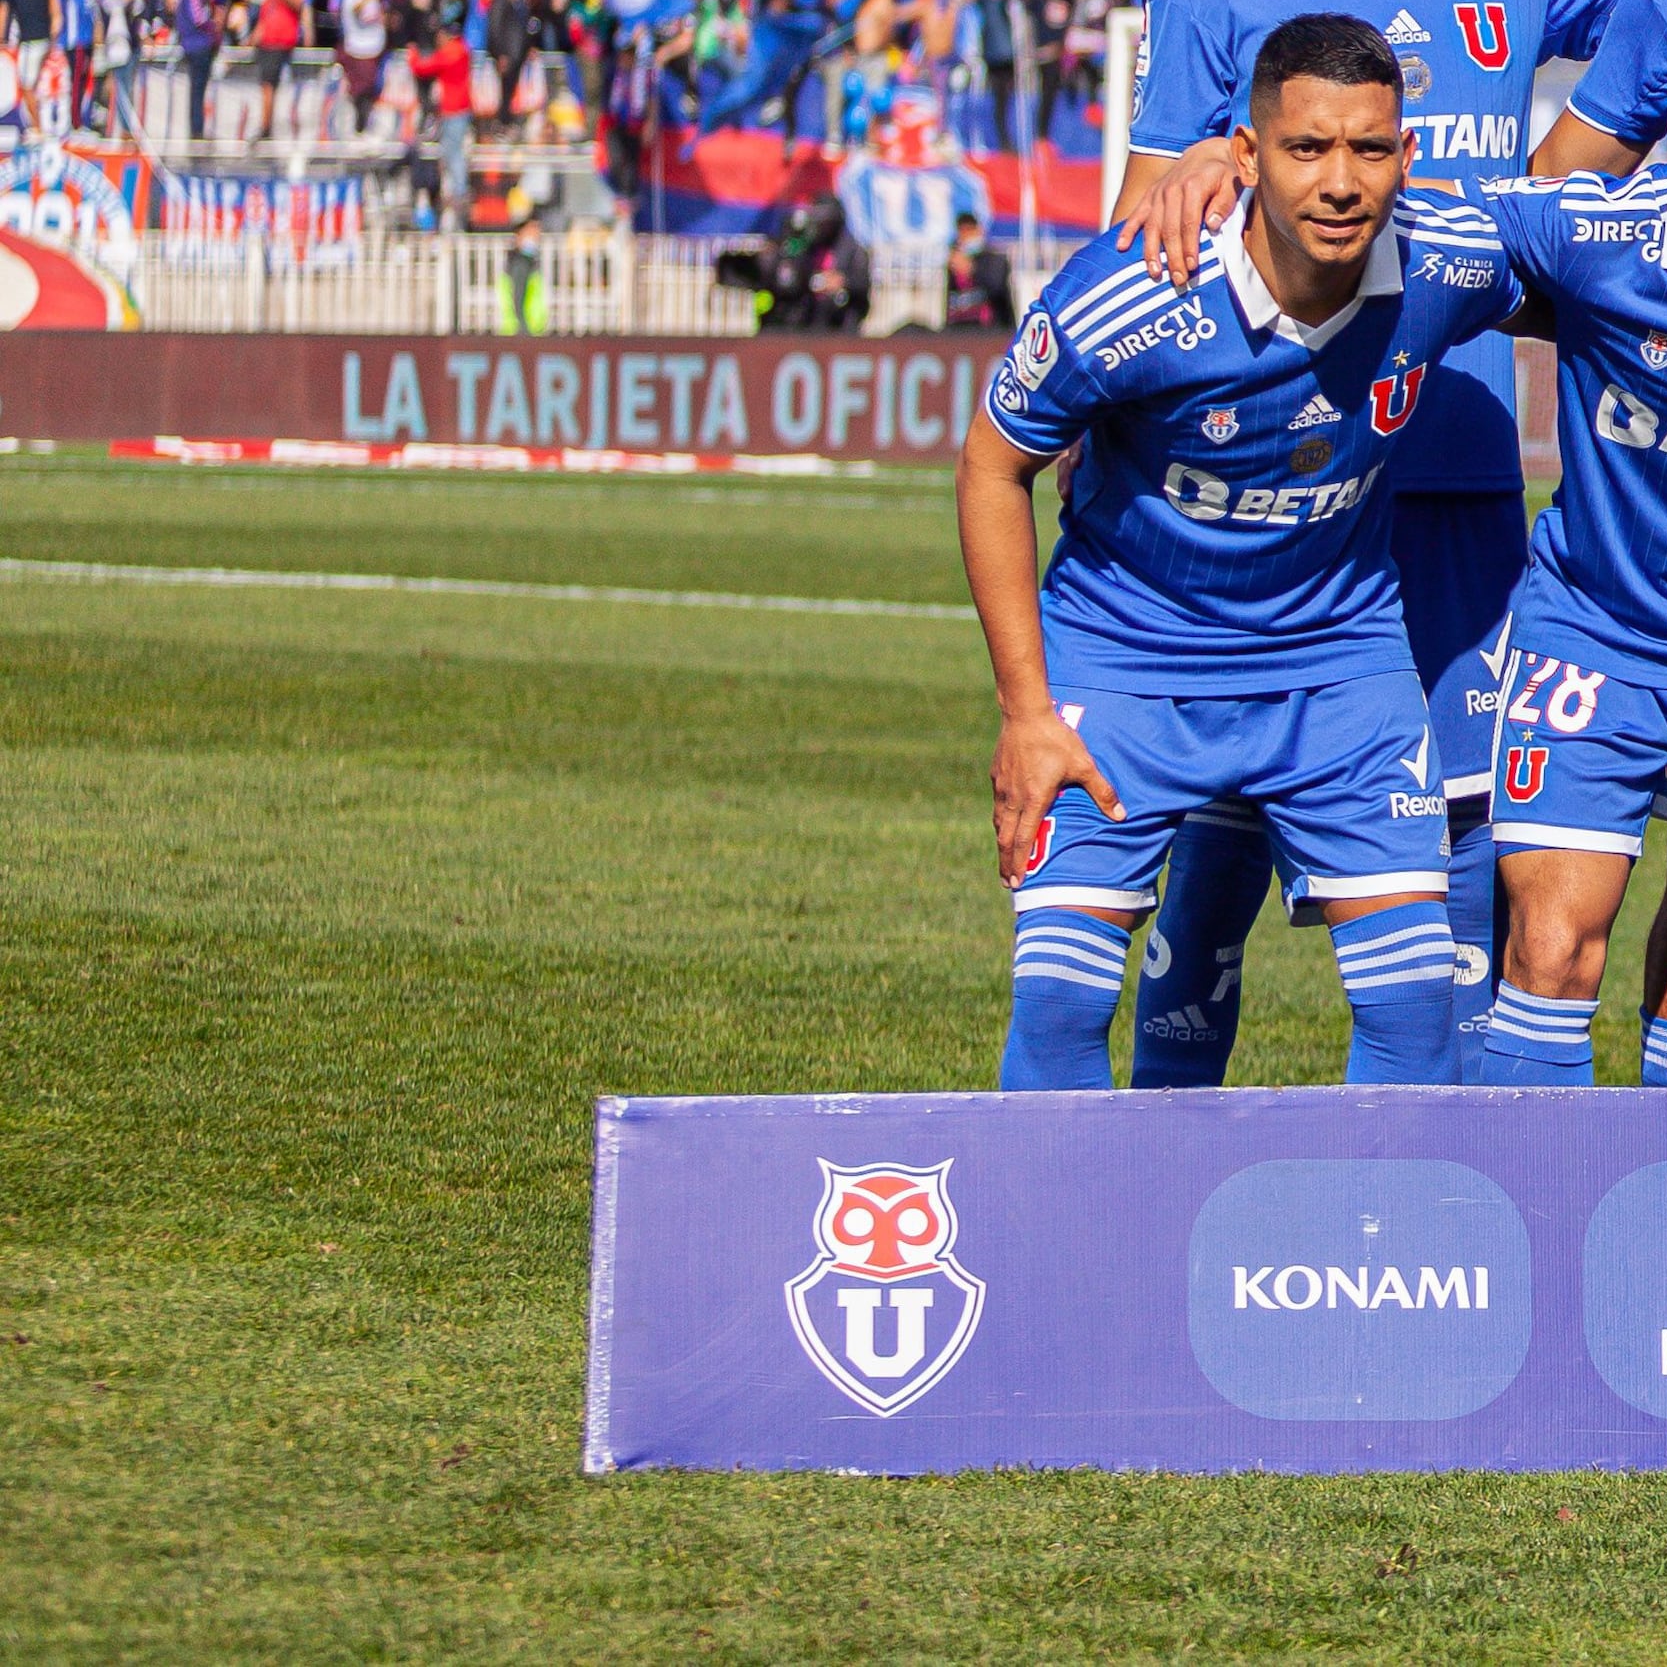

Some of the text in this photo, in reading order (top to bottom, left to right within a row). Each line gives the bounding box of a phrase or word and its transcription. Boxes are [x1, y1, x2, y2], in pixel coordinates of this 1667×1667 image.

[1453, 2, 1512, 72] U
[1402, 114, 1517, 161] ETANO
[1572, 216, 1664, 245] DIRECT
[1442, 262, 1495, 290] MEDS
[1453, 255, 1494, 269] CLINICA
[1095, 295, 1204, 371] DIRECTV
[1175, 316, 1217, 352] GO
[343, 349, 428, 439] LA
[446, 351, 748, 451] TARJETA
[773, 352, 985, 450] OFICI
[1288, 409, 1343, 431] adidas
[1370, 362, 1428, 436] U
[1231, 459, 1388, 526] BETAN
[1465, 689, 1501, 716] Rex
[1505, 746, 1549, 804] U
[1390, 791, 1446, 820] Rexon
[1143, 1016, 1220, 1043] adidas
[1231, 1265, 1490, 1311] KONAMI
[837, 1288, 934, 1378] U
